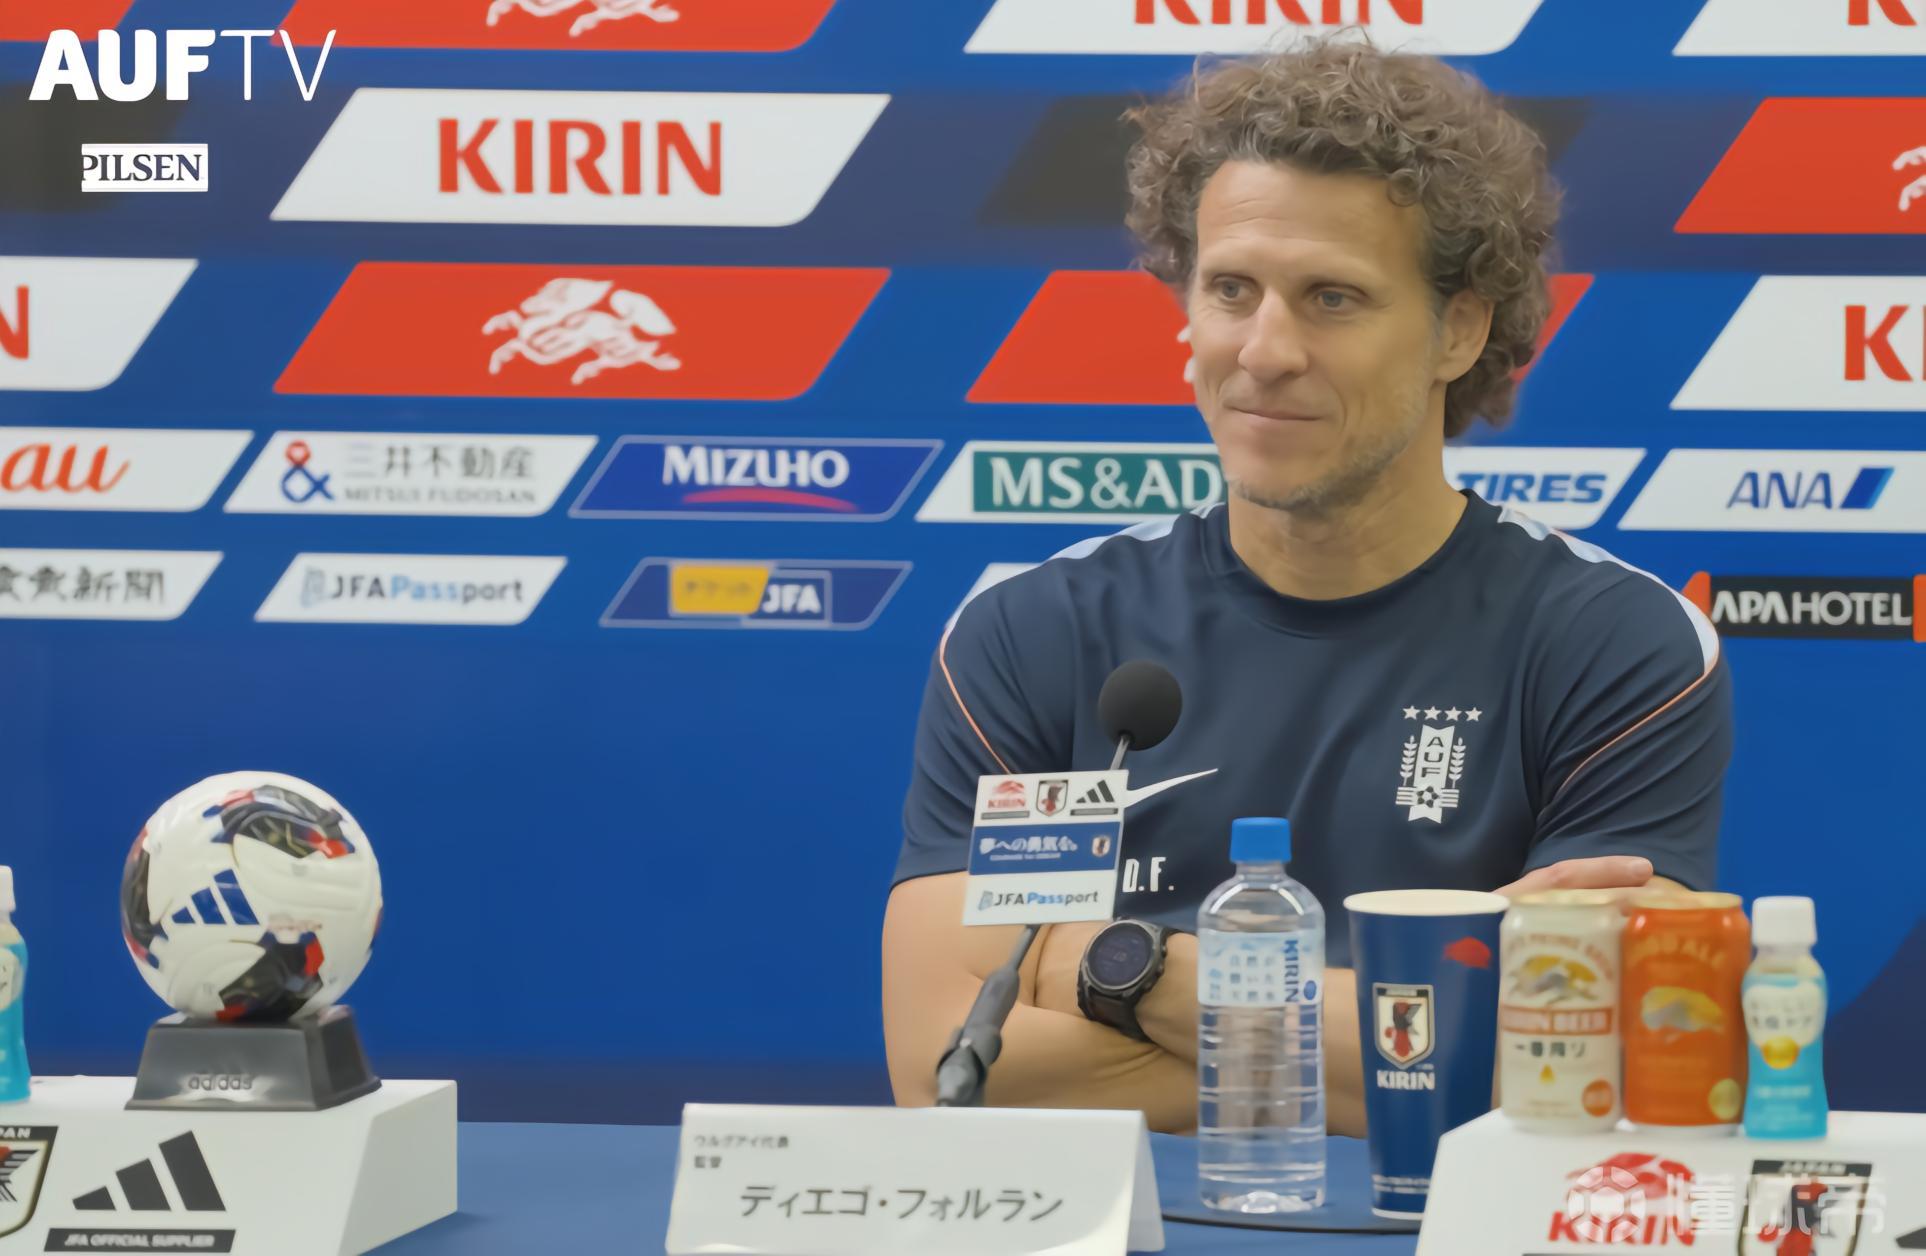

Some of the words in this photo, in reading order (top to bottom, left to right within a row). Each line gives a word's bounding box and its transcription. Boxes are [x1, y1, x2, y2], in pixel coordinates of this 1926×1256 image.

[437, 118, 722, 196] KIRIN
[0, 443, 130, 493] au
[344, 442, 536, 480] 三井不動産
[663, 446, 850, 488] MIZUHO
[989, 456, 1224, 509] MS&AD
[1457, 473, 1607, 504] TIRES
[1726, 471, 1833, 509] ANA
[761, 583, 822, 614] JFA
[1711, 591, 1788, 624] APA
[1791, 591, 1913, 626] HOTEL
[1420, 736, 1444, 778] AUF
[1283, 940, 1299, 1003] KIRIN
[188, 1073, 252, 1091] adidas
[1376, 1070, 1435, 1091] KIRIN
